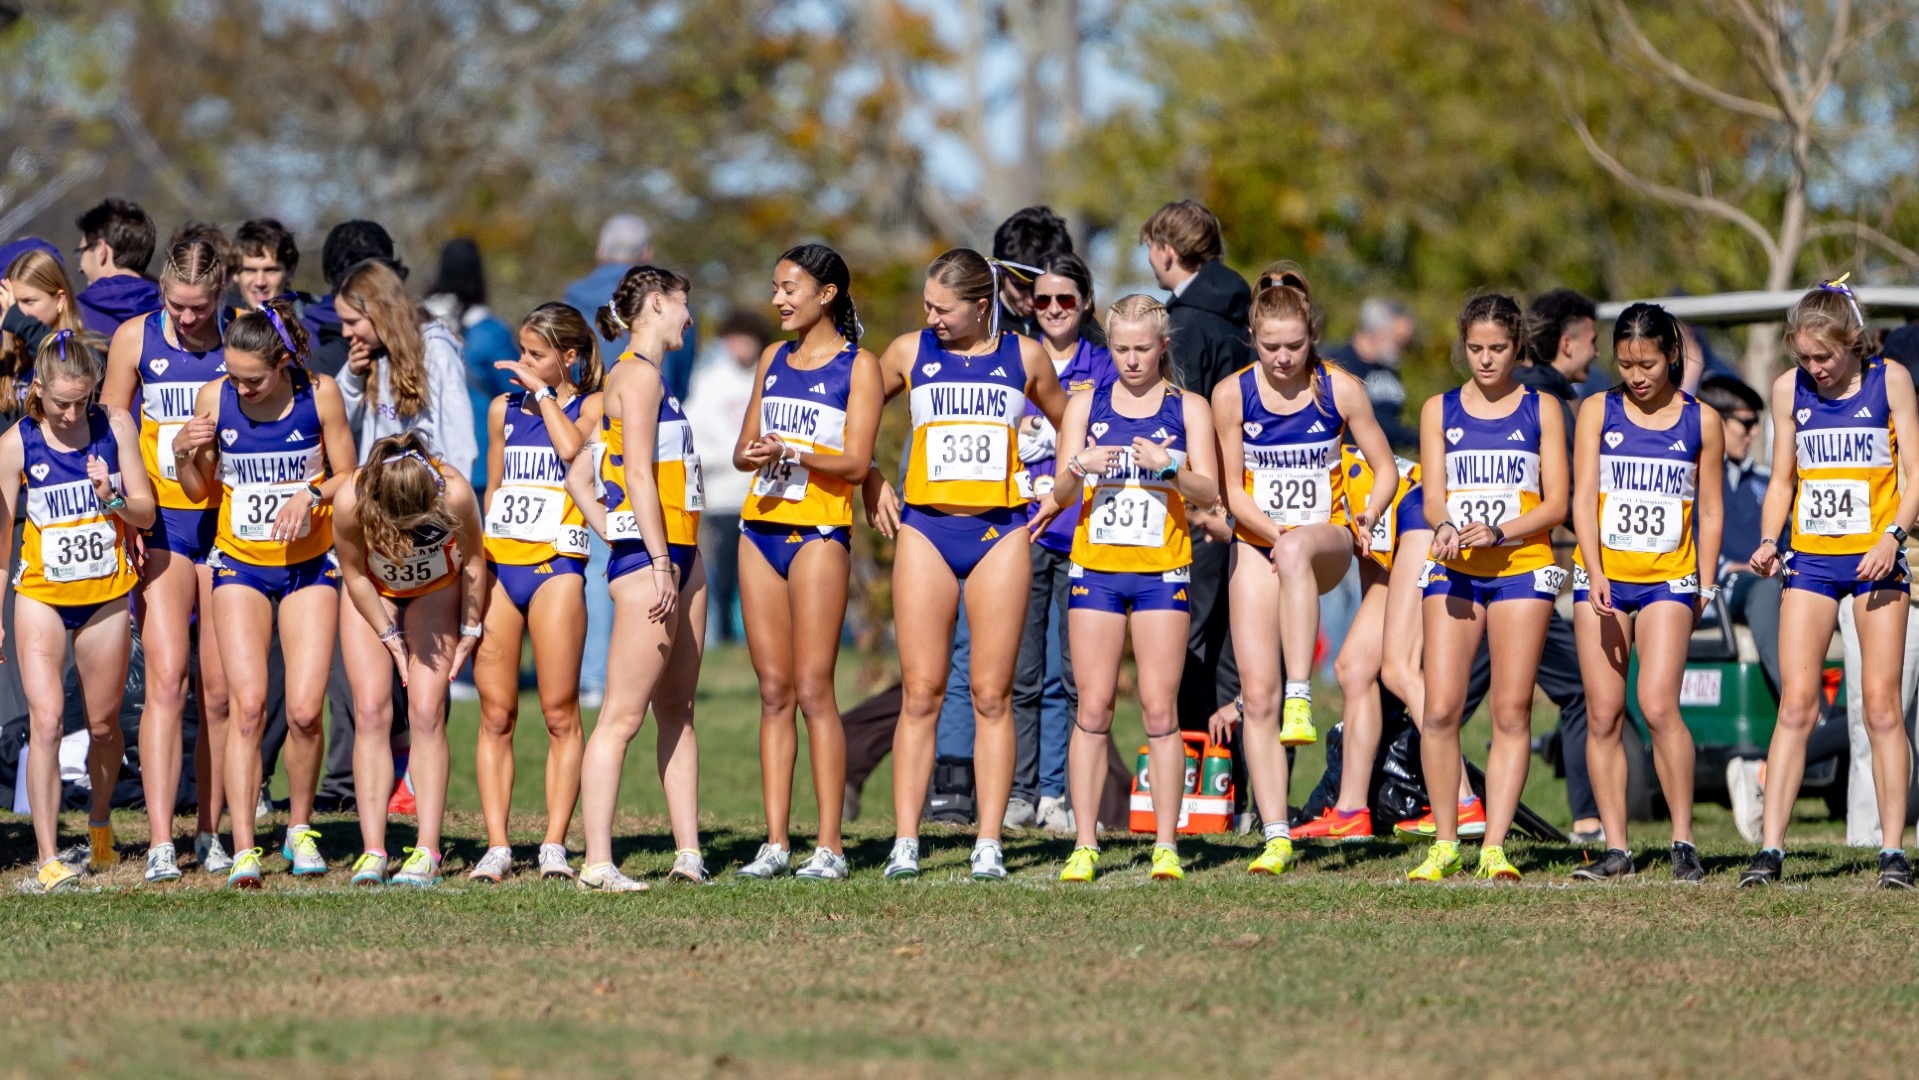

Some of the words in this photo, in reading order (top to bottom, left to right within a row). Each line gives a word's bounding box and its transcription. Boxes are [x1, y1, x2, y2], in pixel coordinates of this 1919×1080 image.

[930, 387, 1008, 418] WILLIAMS
[763, 402, 820, 437] WILLIAMS
[942, 434, 991, 464] 338
[1253, 446, 1328, 470] WILLIAMS
[1803, 433, 1874, 464] WILLIAMS
[232, 455, 307, 484] WILLIAMS
[504, 452, 566, 482] WILLIAMS
[1454, 455, 1526, 485] WILLIAMS
[1611, 461, 1686, 494] WILLIAMS
[501, 494, 547, 525] 337
[1269, 479, 1317, 510] 329
[1810, 488, 1854, 519] 334
[1103, 496, 1150, 528] 331
[1460, 500, 1507, 528] 332
[1617, 503, 1665, 536] 333
[57, 531, 104, 565] 336
[568, 528, 590, 550] 337
[382, 560, 432, 582] 335
[1543, 569, 1565, 590] 332
